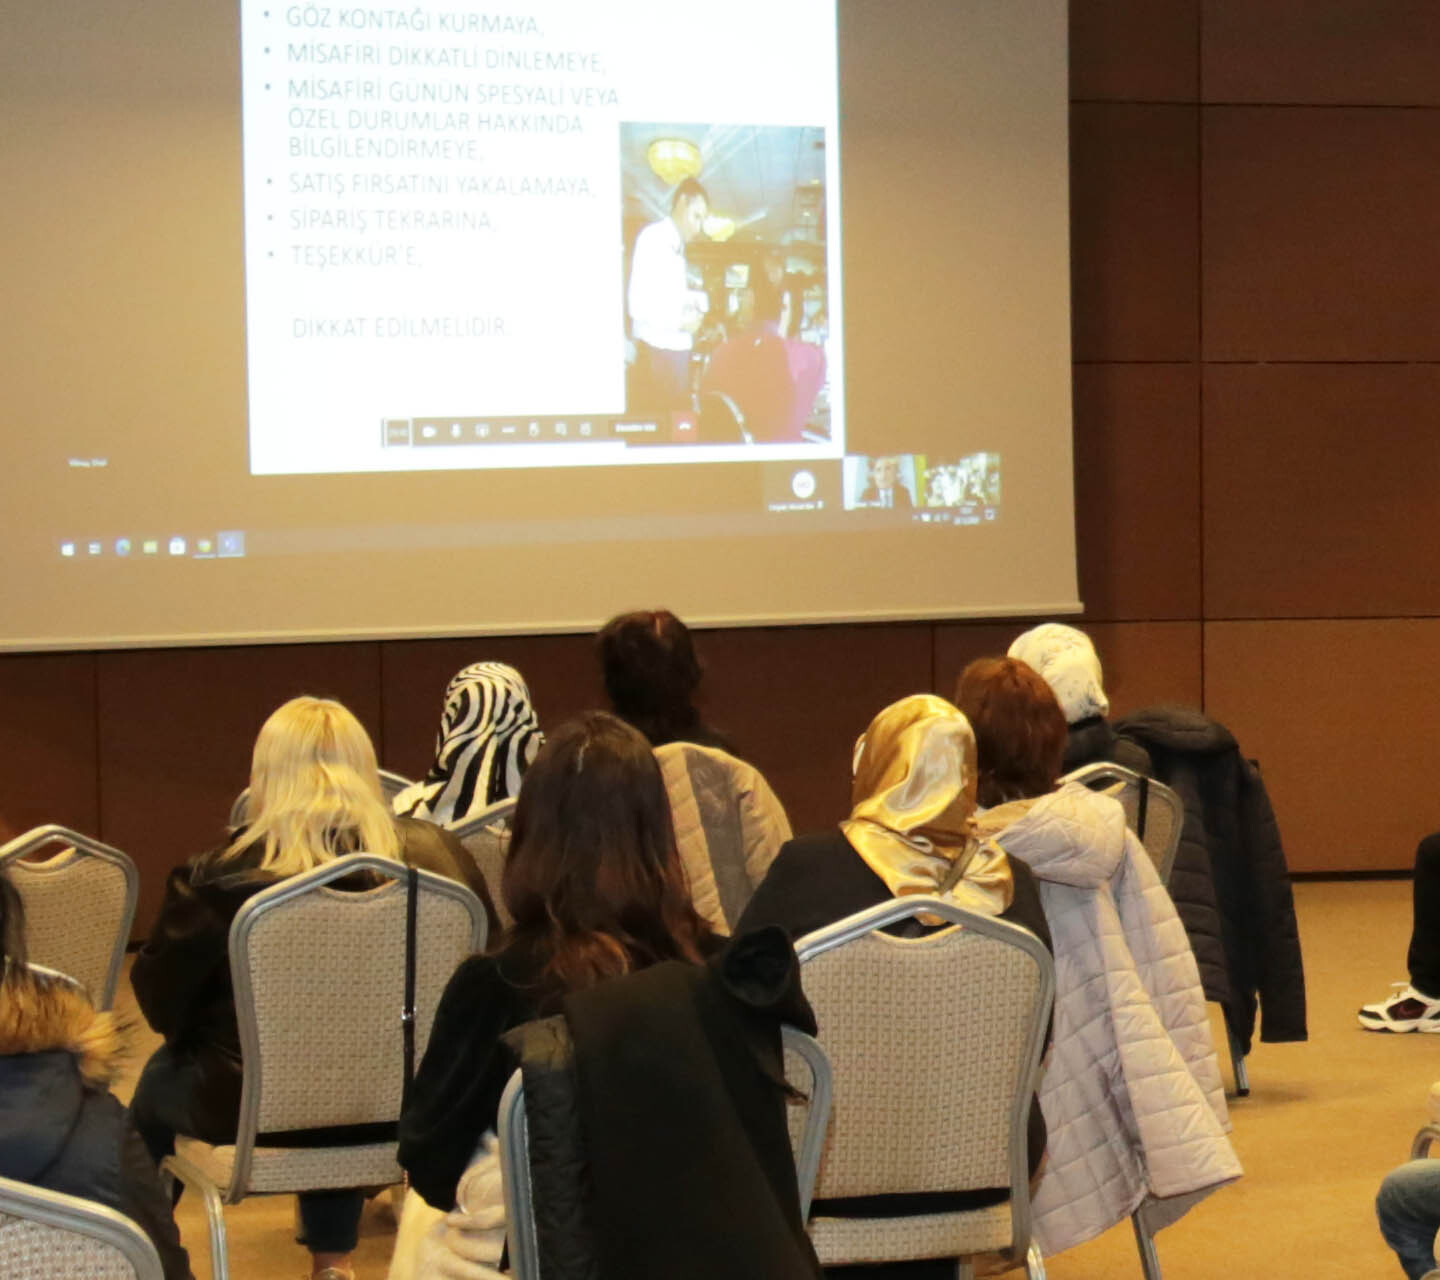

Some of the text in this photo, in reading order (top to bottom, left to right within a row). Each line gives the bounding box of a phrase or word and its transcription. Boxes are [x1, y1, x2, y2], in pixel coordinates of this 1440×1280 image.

[285, 2, 544, 37] GÖZ KONTAĞI KURMAYA,
[389, 80, 470, 103] GÜNÜN
[570, 87, 620, 107] VEYA
[288, 104, 340, 130] ÖZEL
[347, 108, 470, 132] DURUMLAR
[289, 172, 345, 199] SATIŞ
